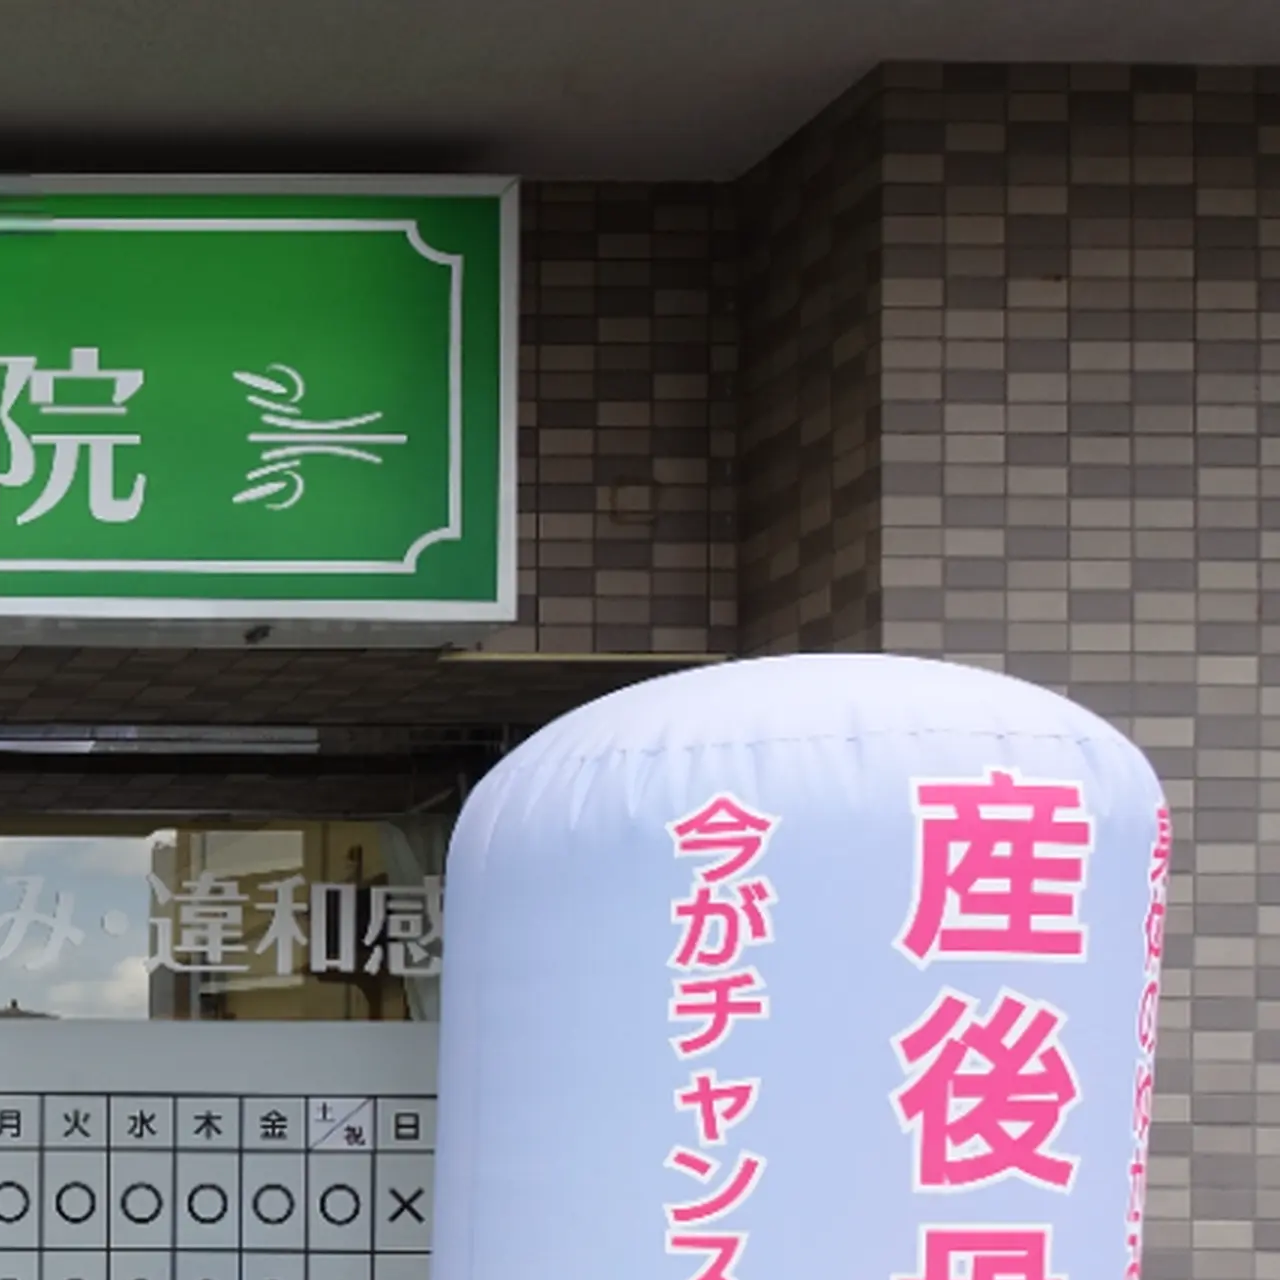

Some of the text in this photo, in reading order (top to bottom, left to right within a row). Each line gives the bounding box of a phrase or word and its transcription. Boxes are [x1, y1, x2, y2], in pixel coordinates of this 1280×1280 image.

[62, 1110, 92, 1140] 火
[127, 1110, 157, 1140] 水
[193, 1110, 223, 1140] 木
[259, 1110, 289, 1140] 金
[315, 1102, 335, 1122] 土
[394, 1112, 420, 1141] 日
